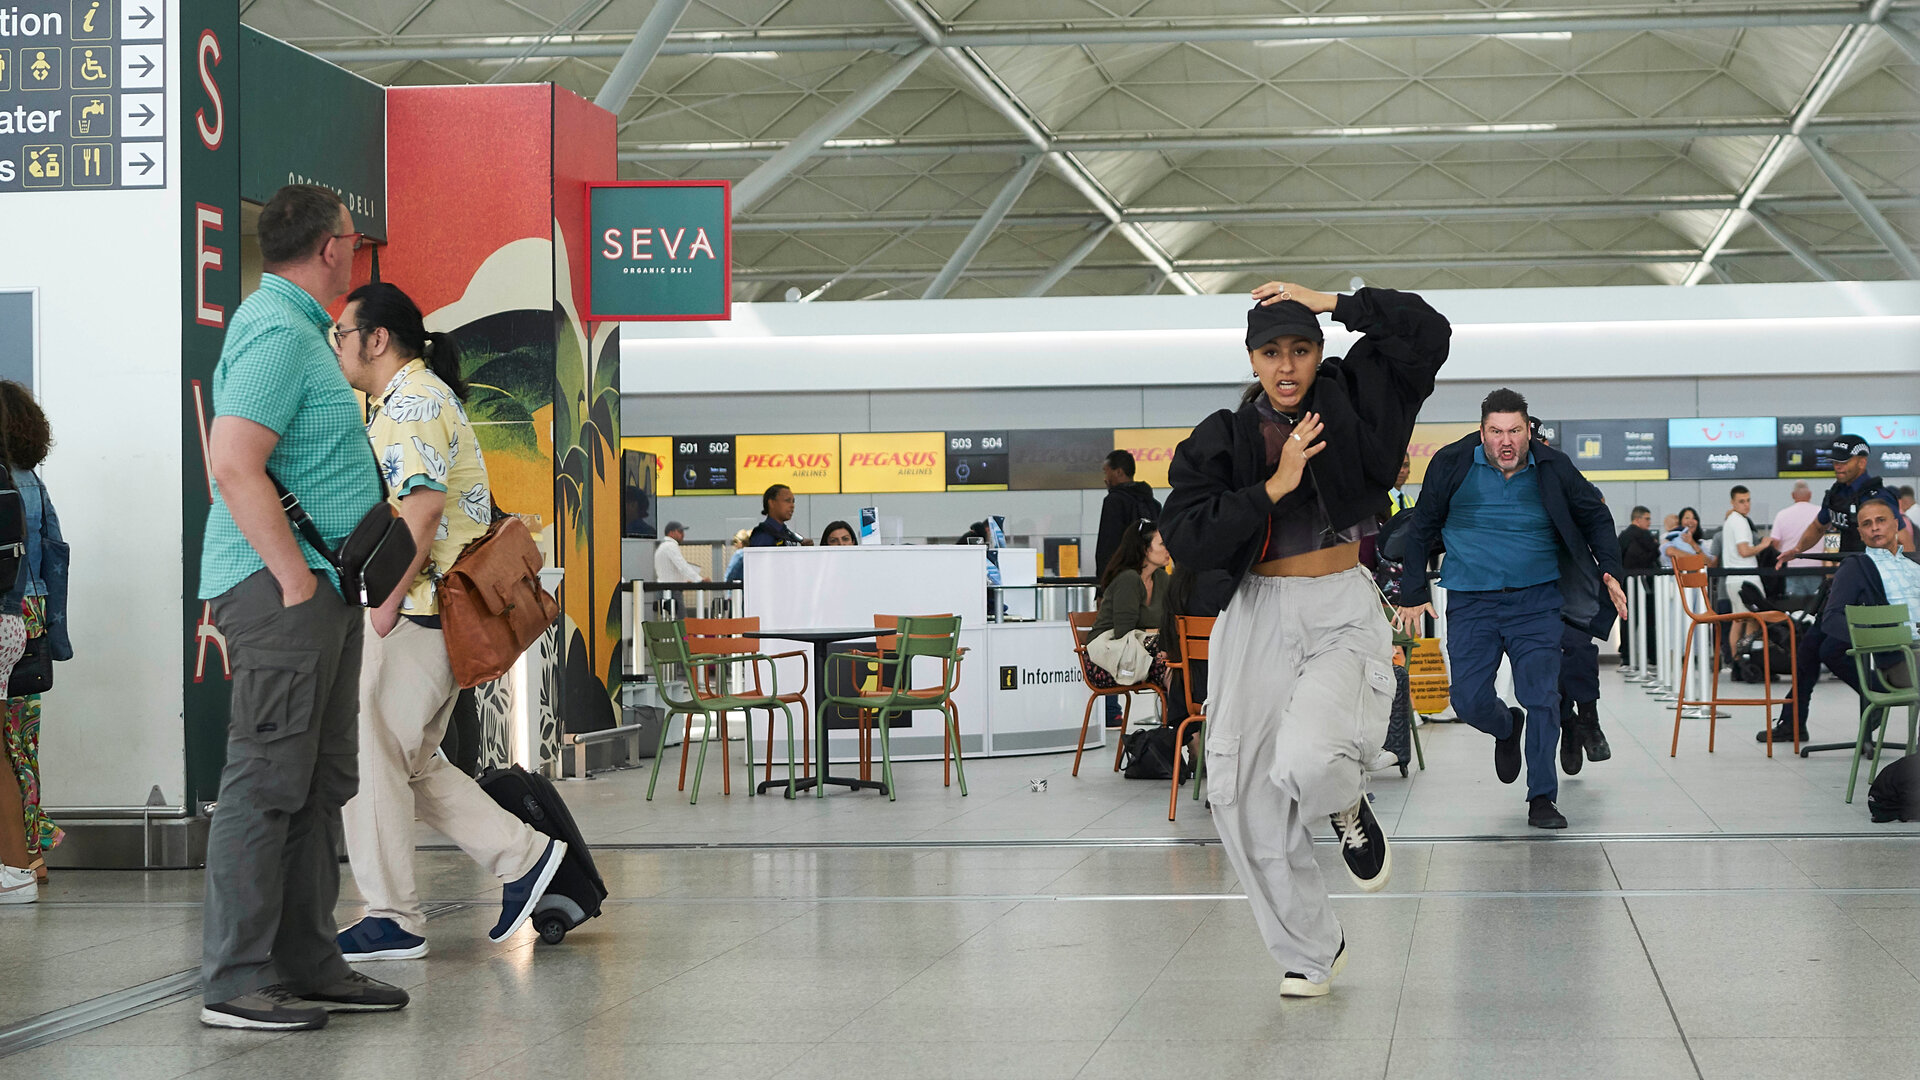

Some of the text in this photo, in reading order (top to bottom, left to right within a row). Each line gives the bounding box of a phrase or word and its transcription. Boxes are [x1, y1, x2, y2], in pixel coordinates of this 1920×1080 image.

[349, 192, 374, 218] DELI
[602, 227, 716, 260] SEVA
[1782, 422, 1836, 434] 509 510
[680, 442, 729, 453] 501 502
[951, 437, 1003, 449] 503 504
[744, 454, 832, 468] PEGASUS
[850, 452, 937, 467] PEGASUS
[1022, 666, 1084, 685] Informatio
